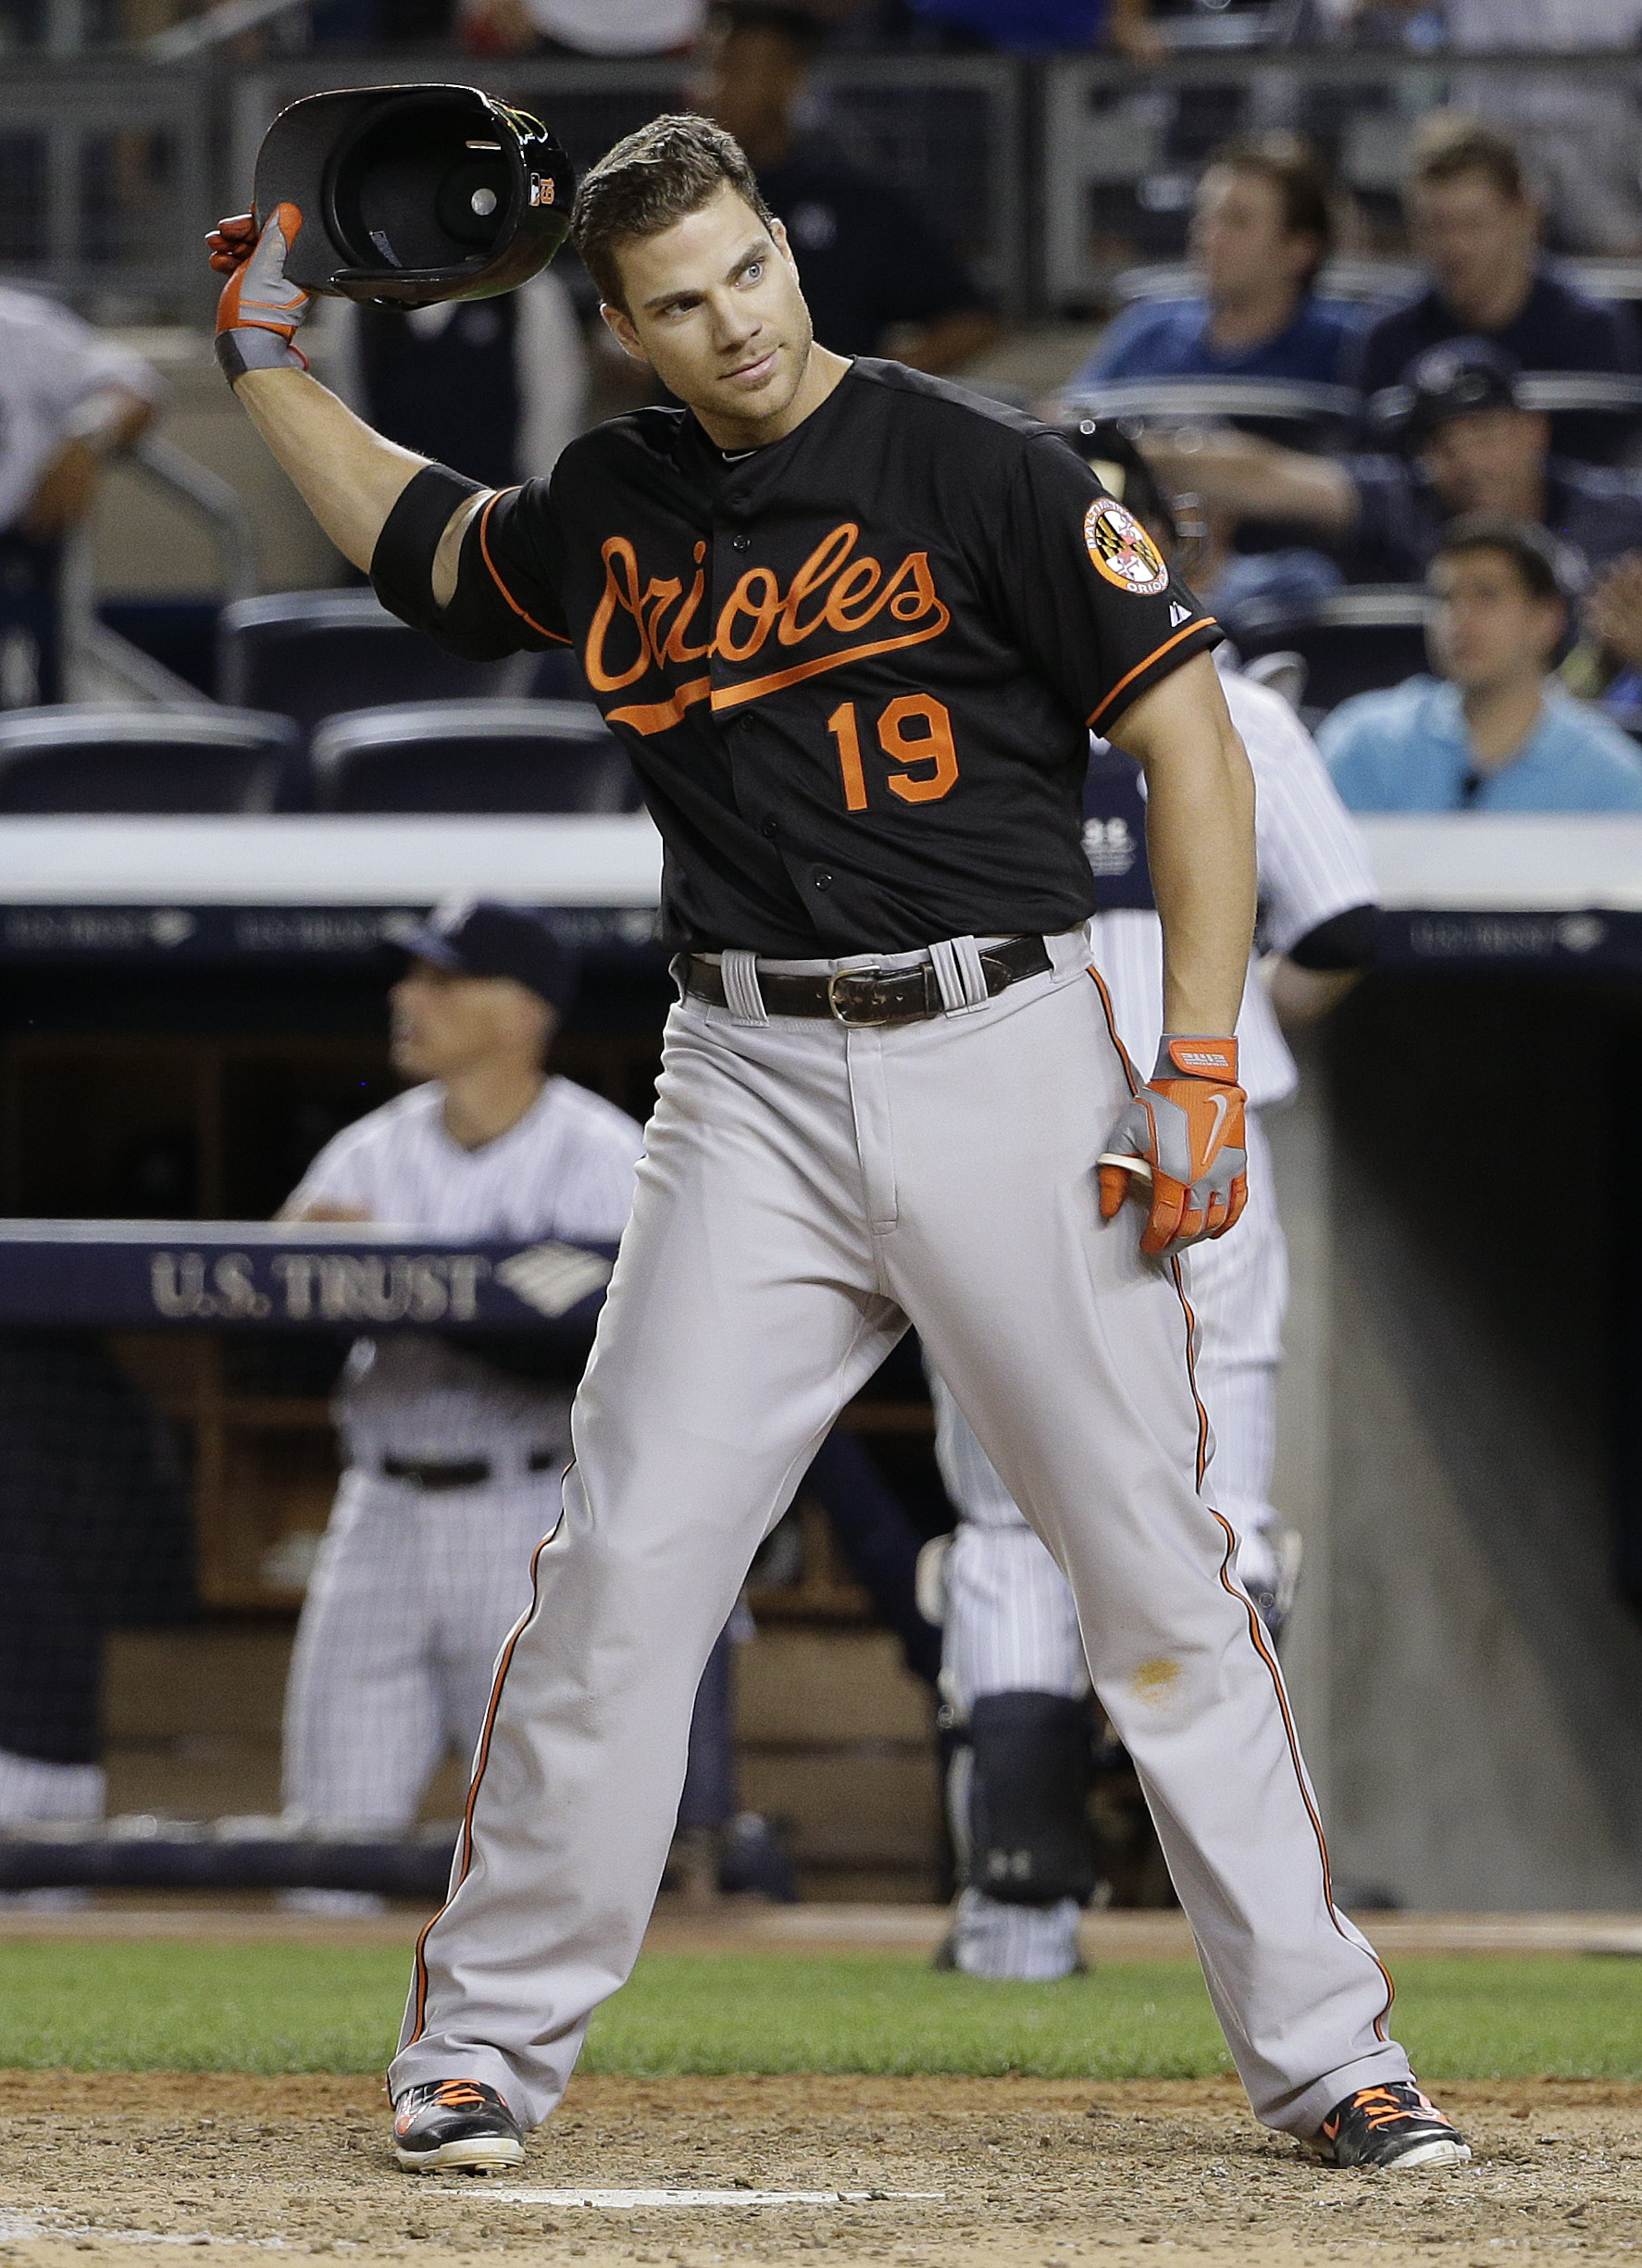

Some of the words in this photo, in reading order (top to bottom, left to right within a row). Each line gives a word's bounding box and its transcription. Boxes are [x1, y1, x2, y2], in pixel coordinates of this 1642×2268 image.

[541, 178, 554, 204] 19
[586, 522, 951, 692] Orioles
[1126, 563, 1169, 593] ORIOLES
[827, 692, 960, 812] 19
[150, 1251, 270, 1320] U.S.
[271, 1252, 491, 1322] TRUST
